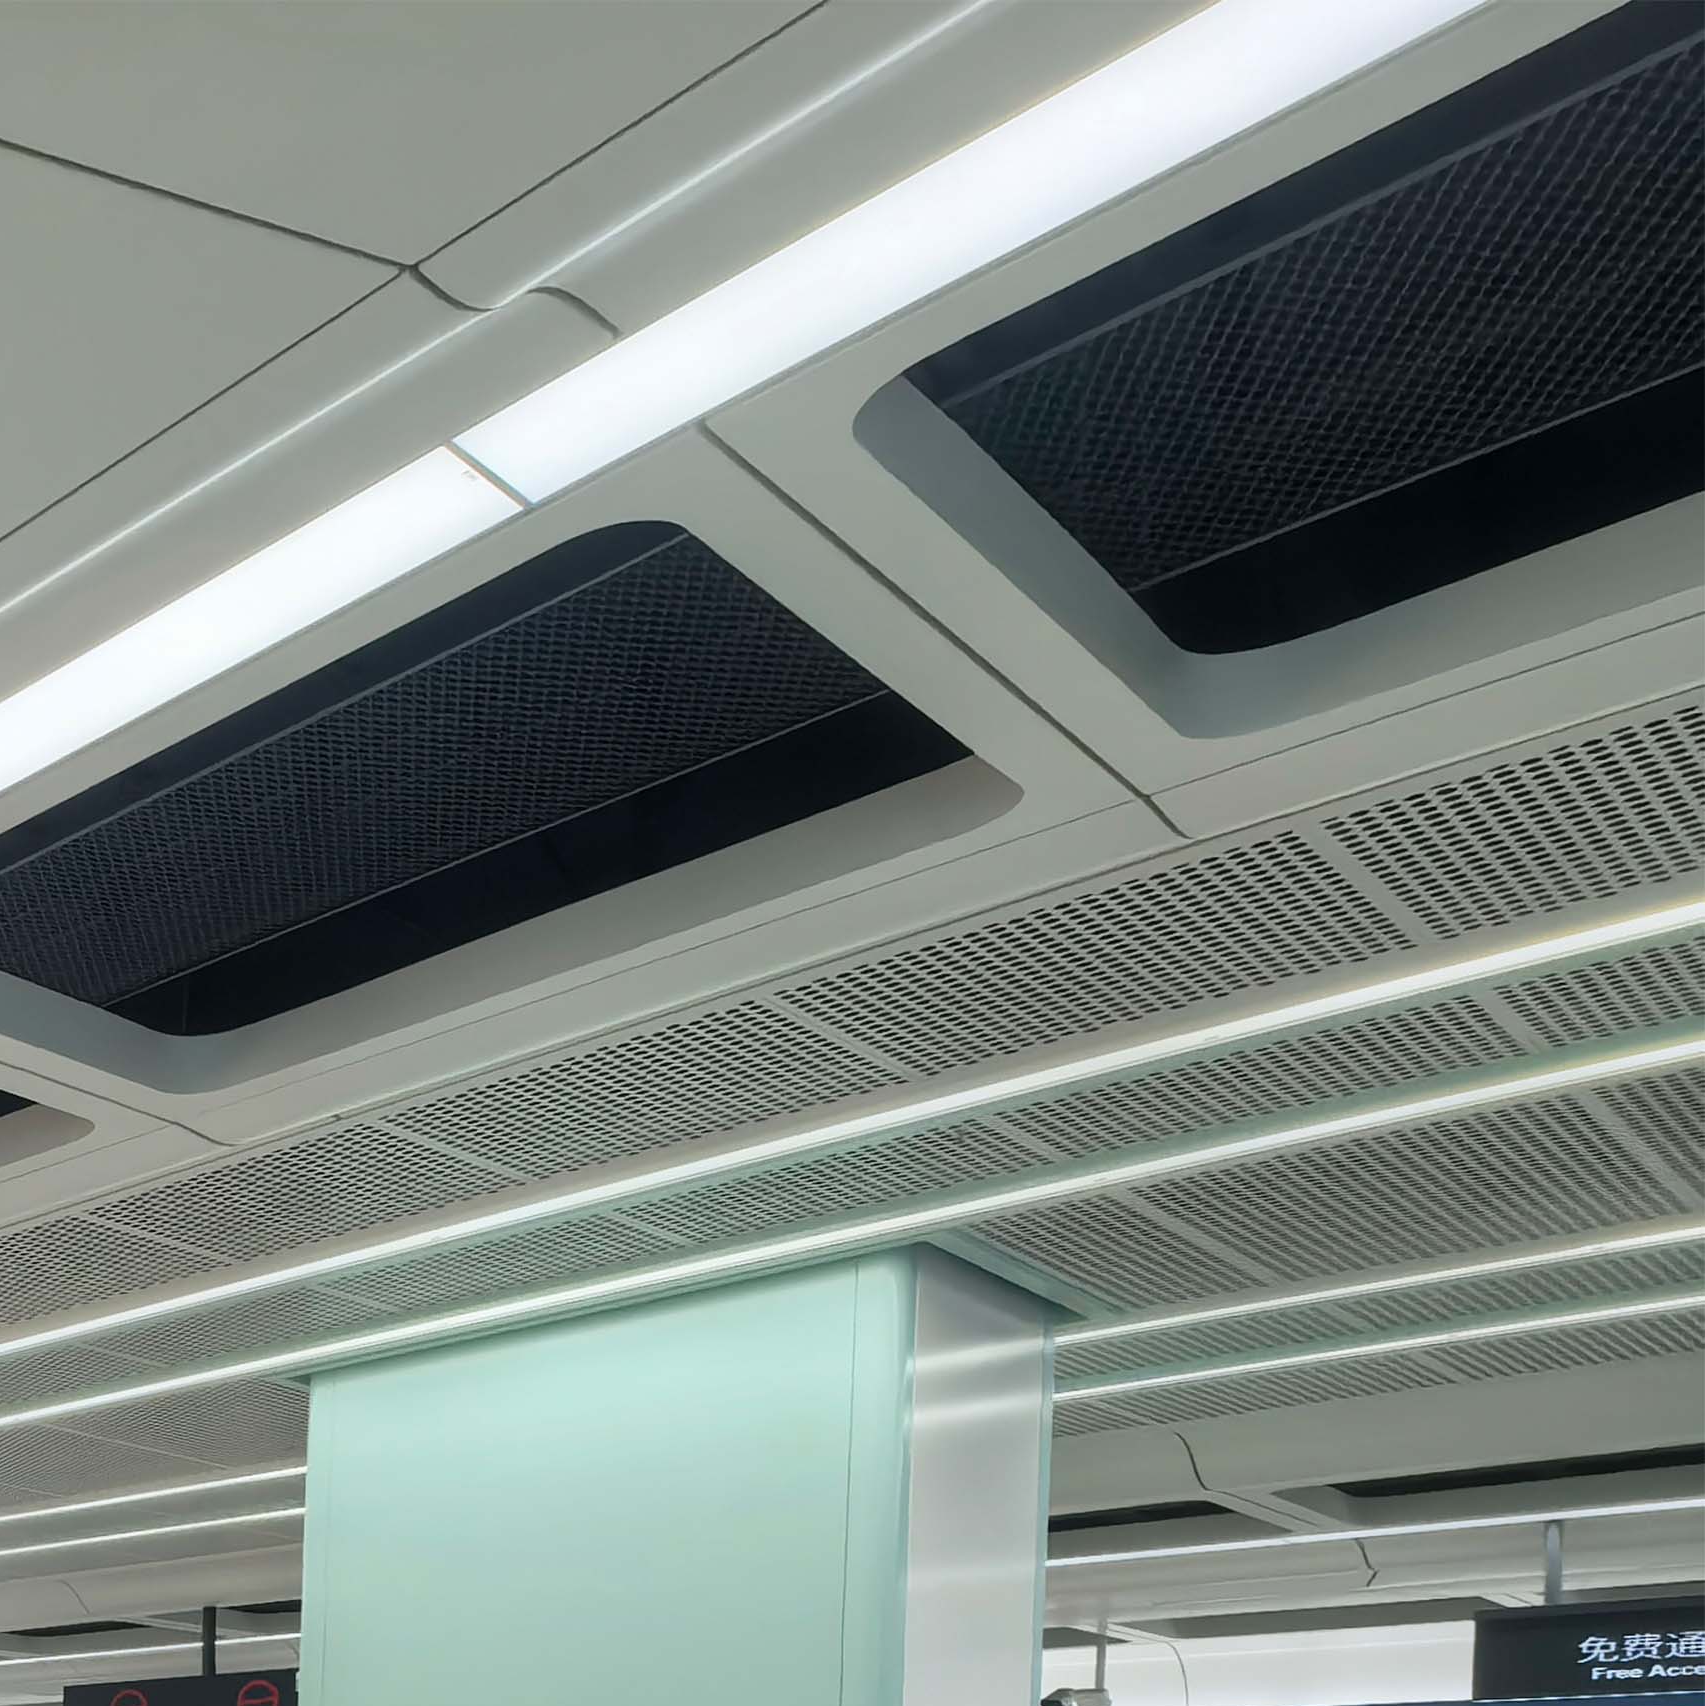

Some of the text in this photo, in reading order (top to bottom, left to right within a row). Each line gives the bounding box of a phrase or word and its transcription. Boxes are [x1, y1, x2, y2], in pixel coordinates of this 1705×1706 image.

[1577, 1630, 1705, 1664] 免费通
[1591, 1666, 1644, 1680] Free
